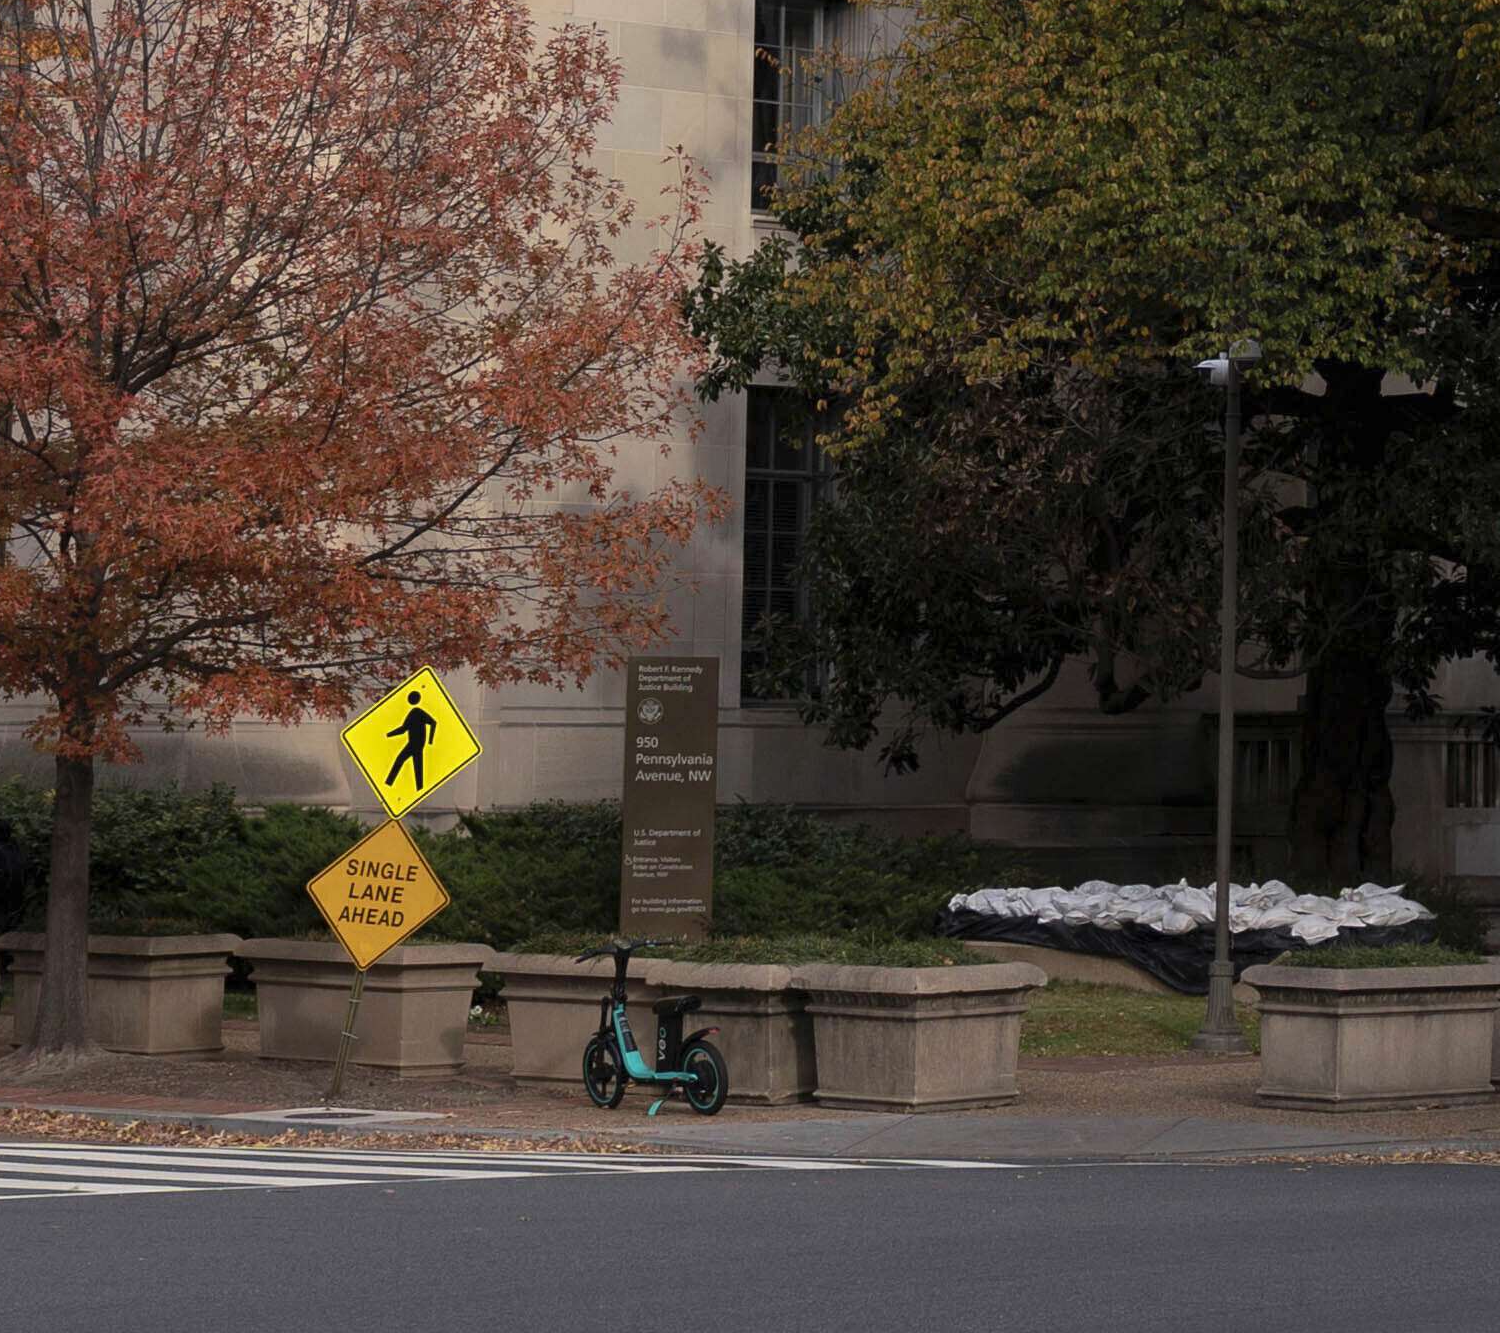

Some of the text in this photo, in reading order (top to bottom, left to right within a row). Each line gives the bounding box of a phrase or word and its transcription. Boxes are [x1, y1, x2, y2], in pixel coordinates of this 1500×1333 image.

[638, 664, 663, 673] Robert
[671, 665, 704, 674] Kennedy
[638, 673, 692, 682] Department of
[663, 683, 693, 693] Building
[636, 736, 659, 748] 950
[635, 753, 714, 768] Pennsylvania
[635, 770, 712, 783] Avenue, NW
[648, 828, 691, 838] Department
[692, 828, 702, 837] of
[633, 838, 657, 846] Justice
[346, 858, 419, 882] SINGLE
[348, 882, 405, 904] LANE
[337, 905, 405, 928] AHEAD
[657, 1026, 667, 1061] veo
